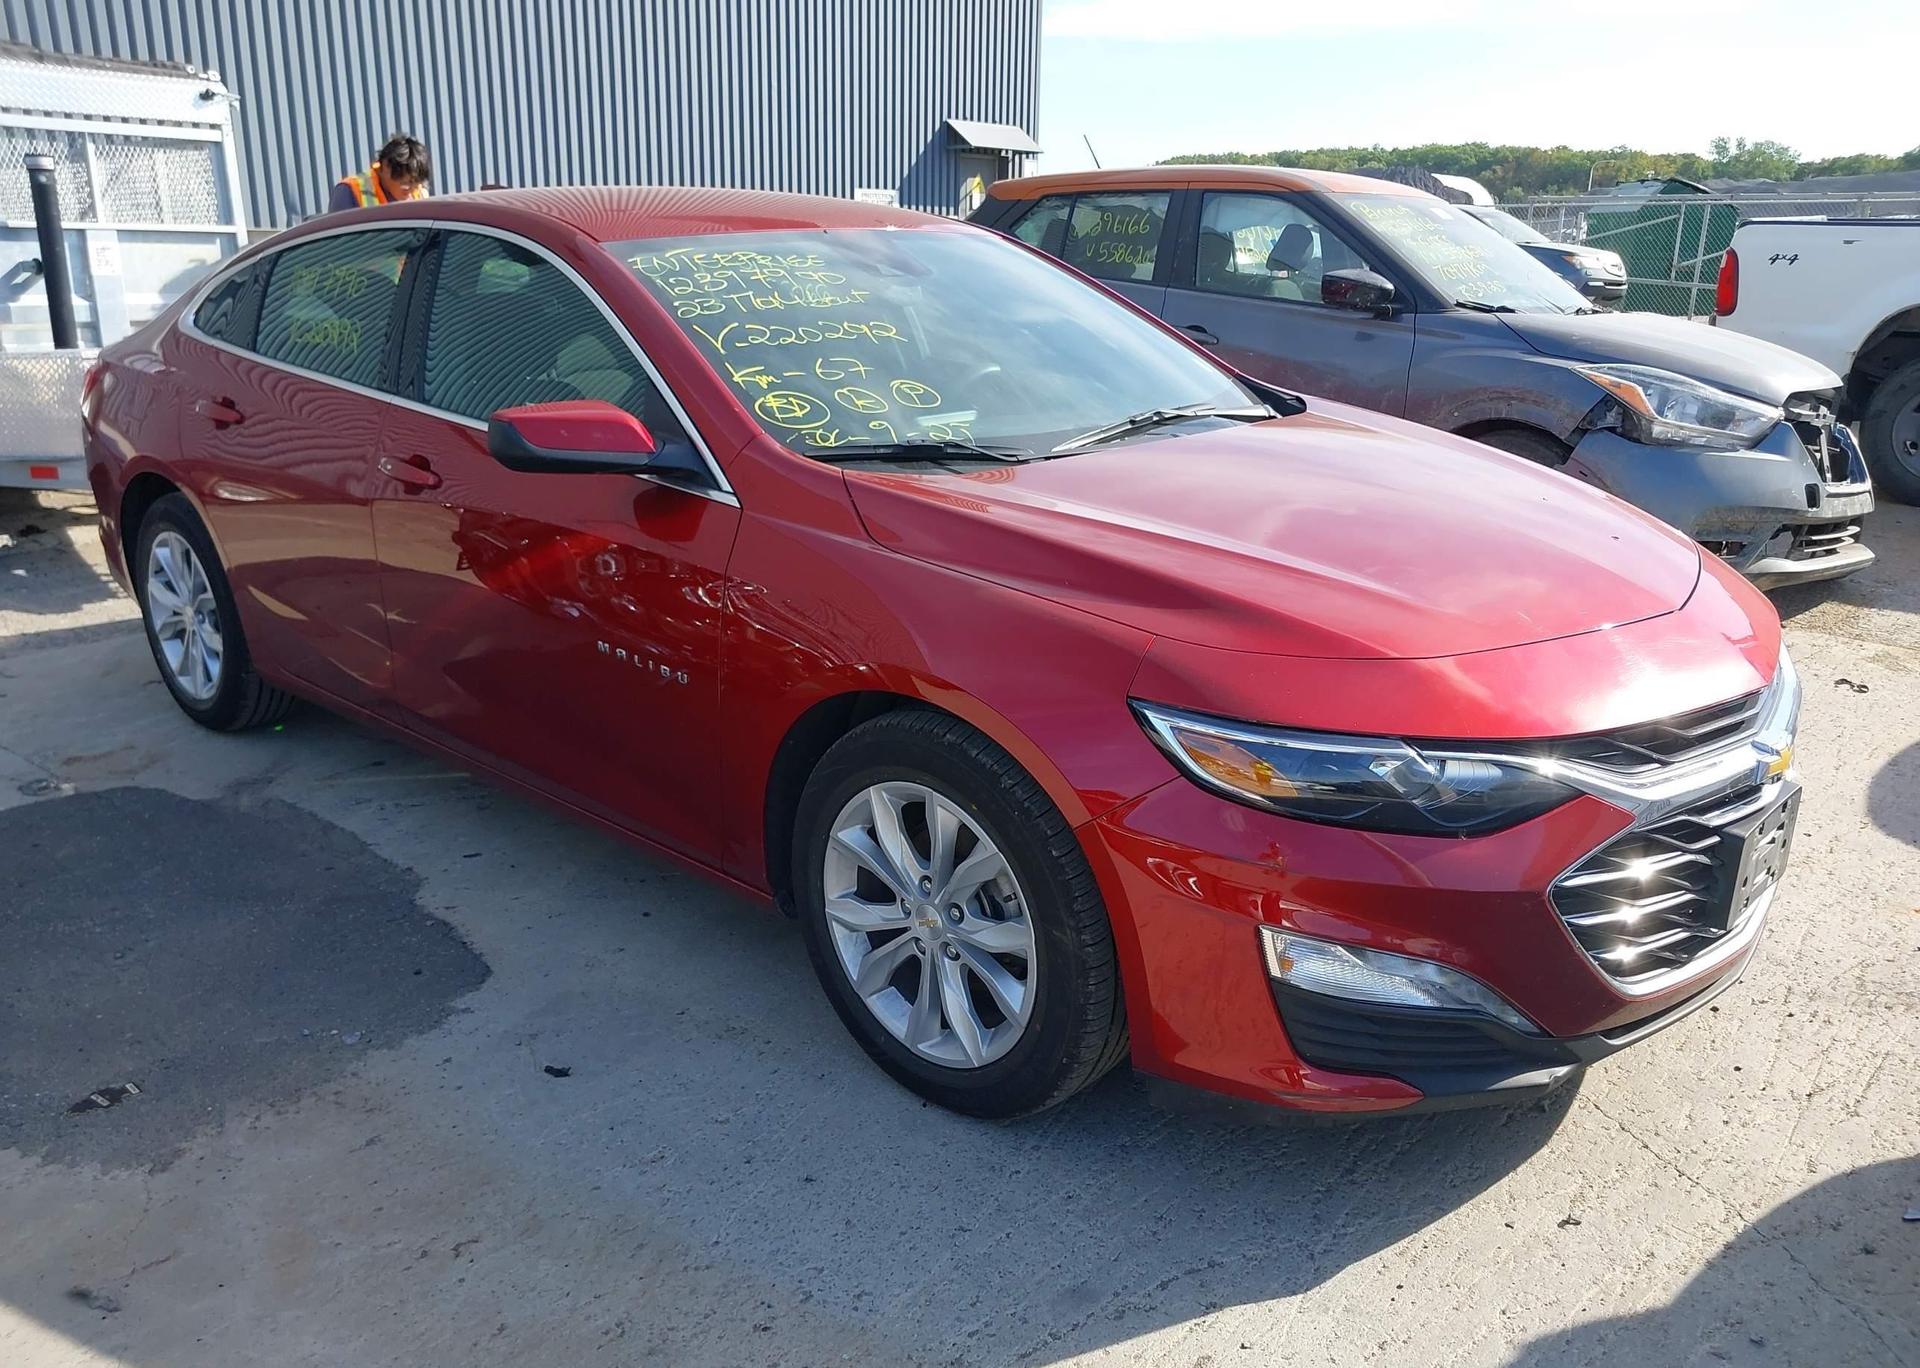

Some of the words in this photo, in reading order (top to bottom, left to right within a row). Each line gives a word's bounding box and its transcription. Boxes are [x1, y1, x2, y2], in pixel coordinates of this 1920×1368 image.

[628, 248, 825, 277] ENTERPRISE
[673, 300, 726, 318] 23
[597, 640, 689, 684] MALIBU
